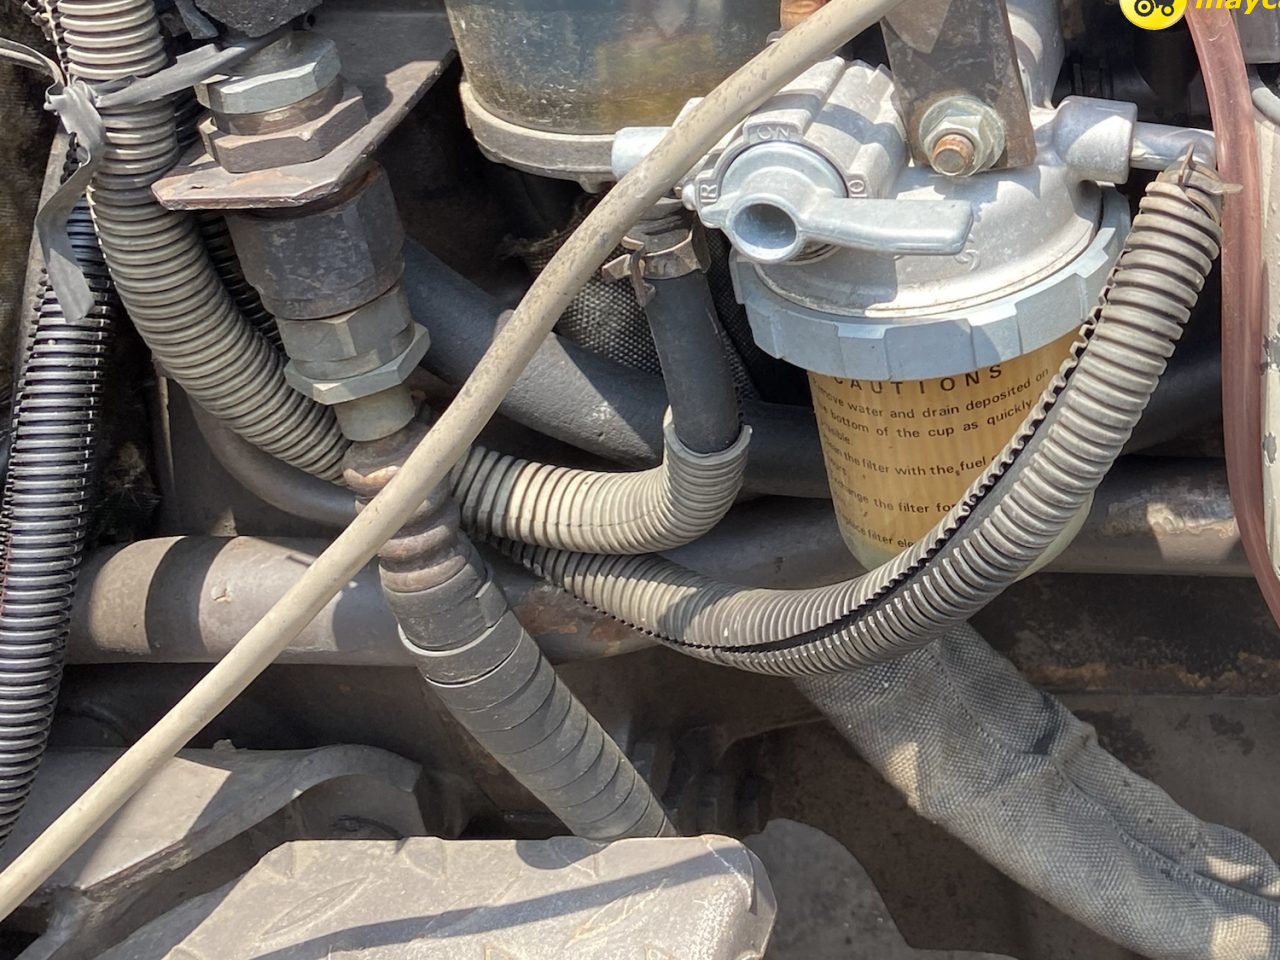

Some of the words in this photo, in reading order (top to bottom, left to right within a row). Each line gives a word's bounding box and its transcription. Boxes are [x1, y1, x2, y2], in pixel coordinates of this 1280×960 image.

[756, 125, 791, 140] ON
[812, 378, 844, 406] move
[847, 401, 883, 417] water
[890, 408, 915, 419] and
[922, 404, 960, 419] drain
[965, 378, 1031, 411] deposited
[1035, 368, 1049, 382] on
[830, 408, 870, 433] bottom
[876, 426, 890, 437] of
[897, 428, 920, 438] the
[928, 426, 955, 438] cup
[963, 421, 979, 432] as
[987, 399, 1033, 426] quickly
[844, 451, 861, 466] the
[862, 458, 890, 474] filter
[895, 465, 926, 477] with
[930, 464, 955, 476] the
[960, 456, 987, 471] fuel
[873, 498, 894, 512] the
[899, 502, 930, 514] filter
[868, 529, 894, 545] filter
[898, 539, 915, 548] ele
